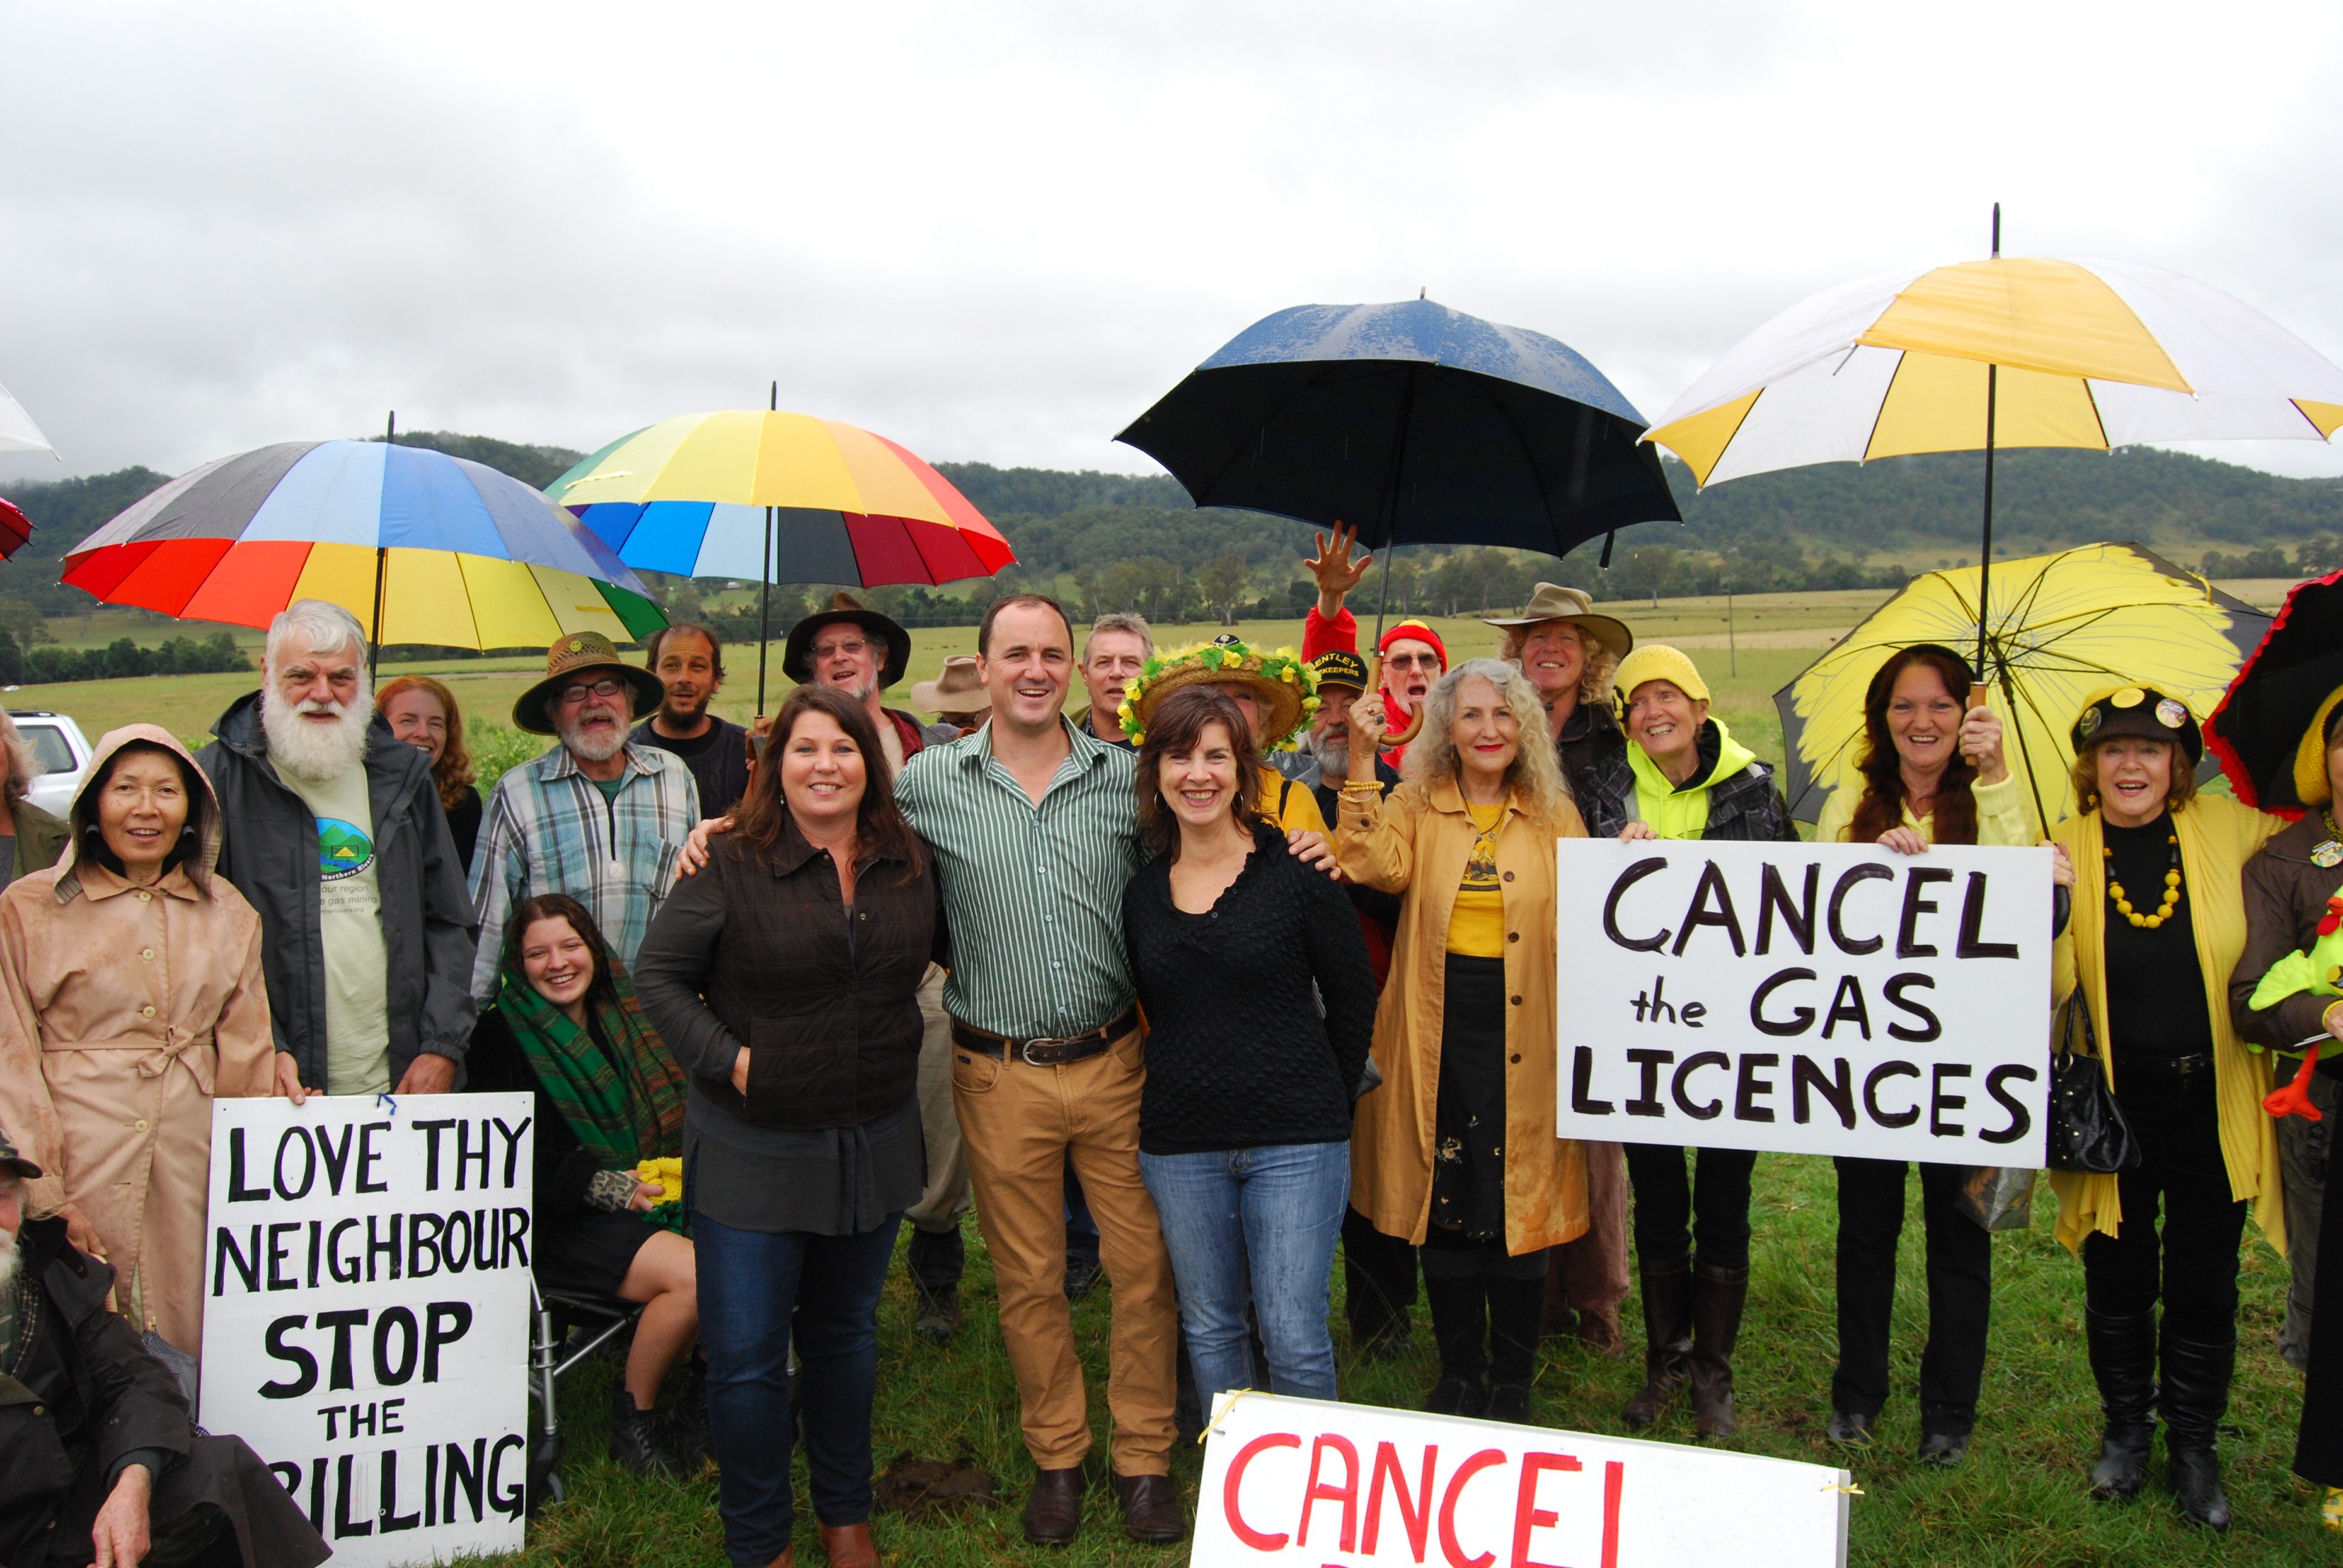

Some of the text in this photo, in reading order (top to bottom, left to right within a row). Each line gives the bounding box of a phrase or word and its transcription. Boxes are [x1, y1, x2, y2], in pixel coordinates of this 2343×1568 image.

[1319, 667, 1359, 676] EKEEPERS
[321, 854, 374, 881] Northern Rivers
[328, 897, 346, 906] gas
[348, 895, 378, 904] mining
[340, 884, 369, 894] region
[1603, 857, 2020, 959] CANCEL
[1630, 967, 1942, 1043] the GAS
[1571, 1045, 2037, 1145] LICENCES
[228, 1117, 532, 1203] LOVE THY
[212, 1207, 530, 1297] NEIGHBOUR
[257, 1301, 473, 1399] STOP
[317, 1398, 405, 1441] THE
